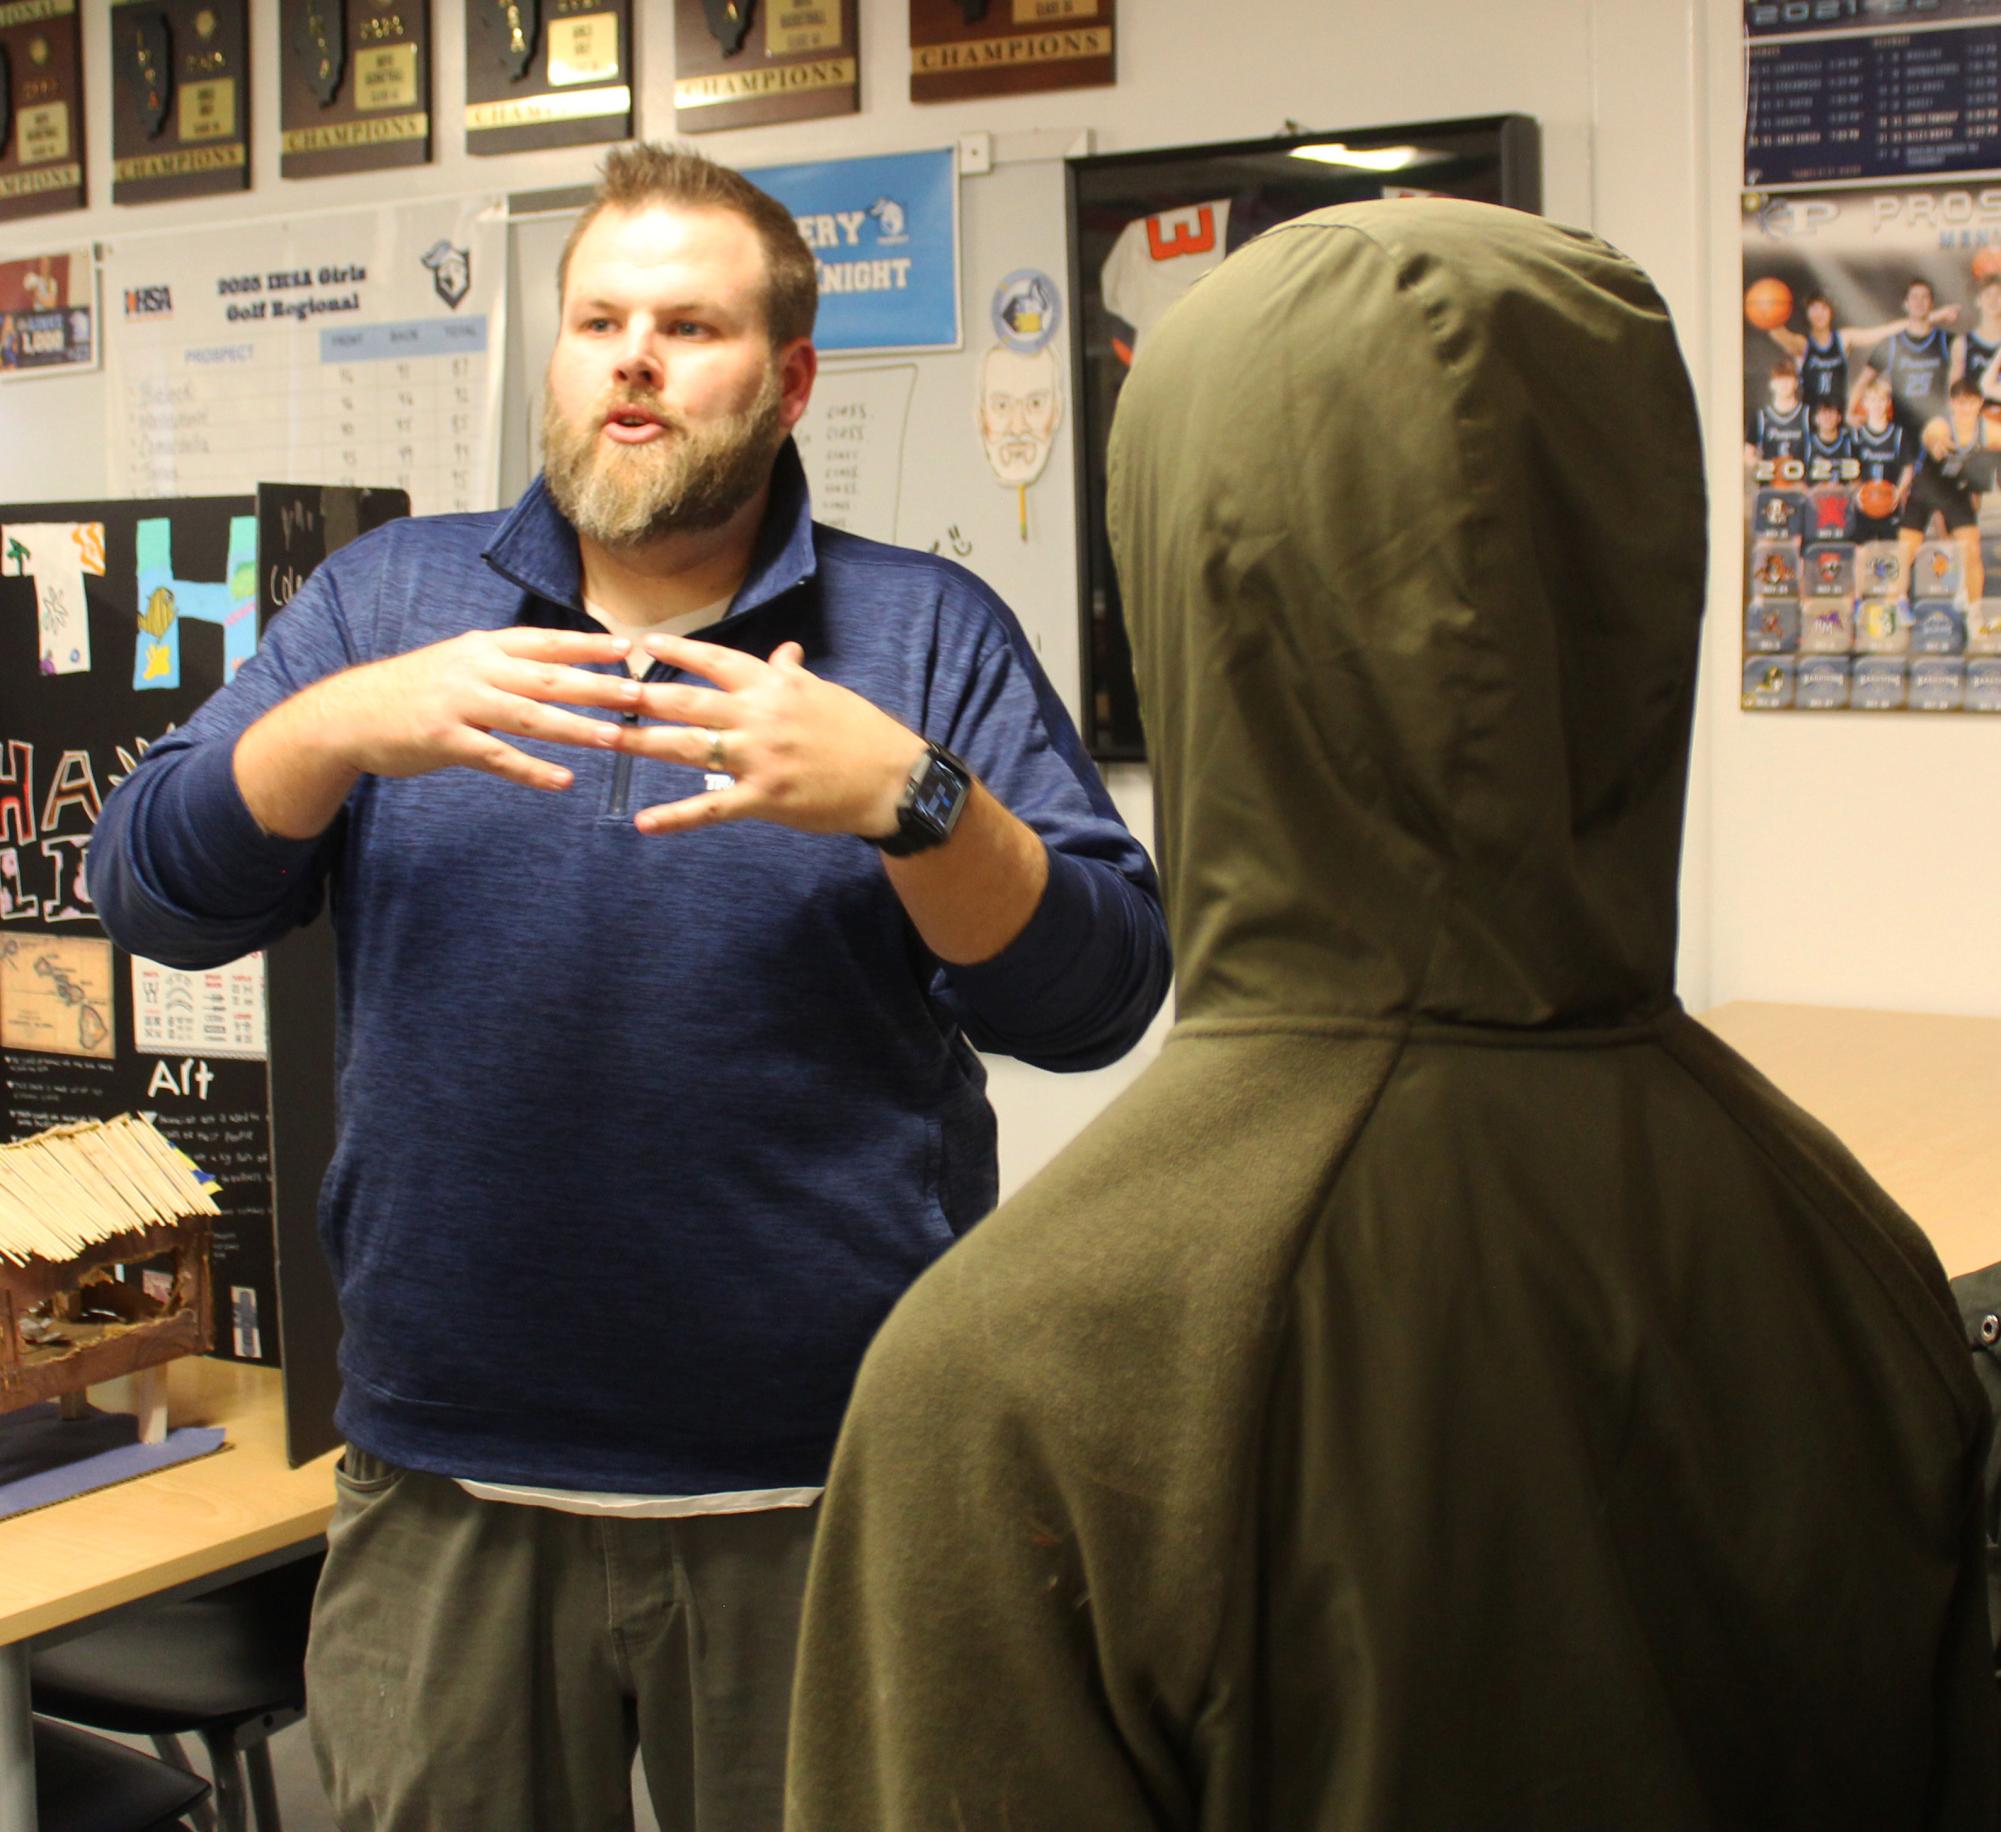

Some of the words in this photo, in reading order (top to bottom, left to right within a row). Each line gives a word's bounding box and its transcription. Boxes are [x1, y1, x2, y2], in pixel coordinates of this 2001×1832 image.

[919, 31, 1099, 68] CHAMPIONS
[684, 61, 844, 96] CHAMPIONS
[287, 114, 419, 148] CHAMPIONS
[118, 148, 238, 178] CHAMPIONS
[318, 264, 367, 286] Girls
[226, 302, 267, 322] Golf
[271, 293, 360, 321] Regional
[184, 344, 254, 365] PROSPECT
